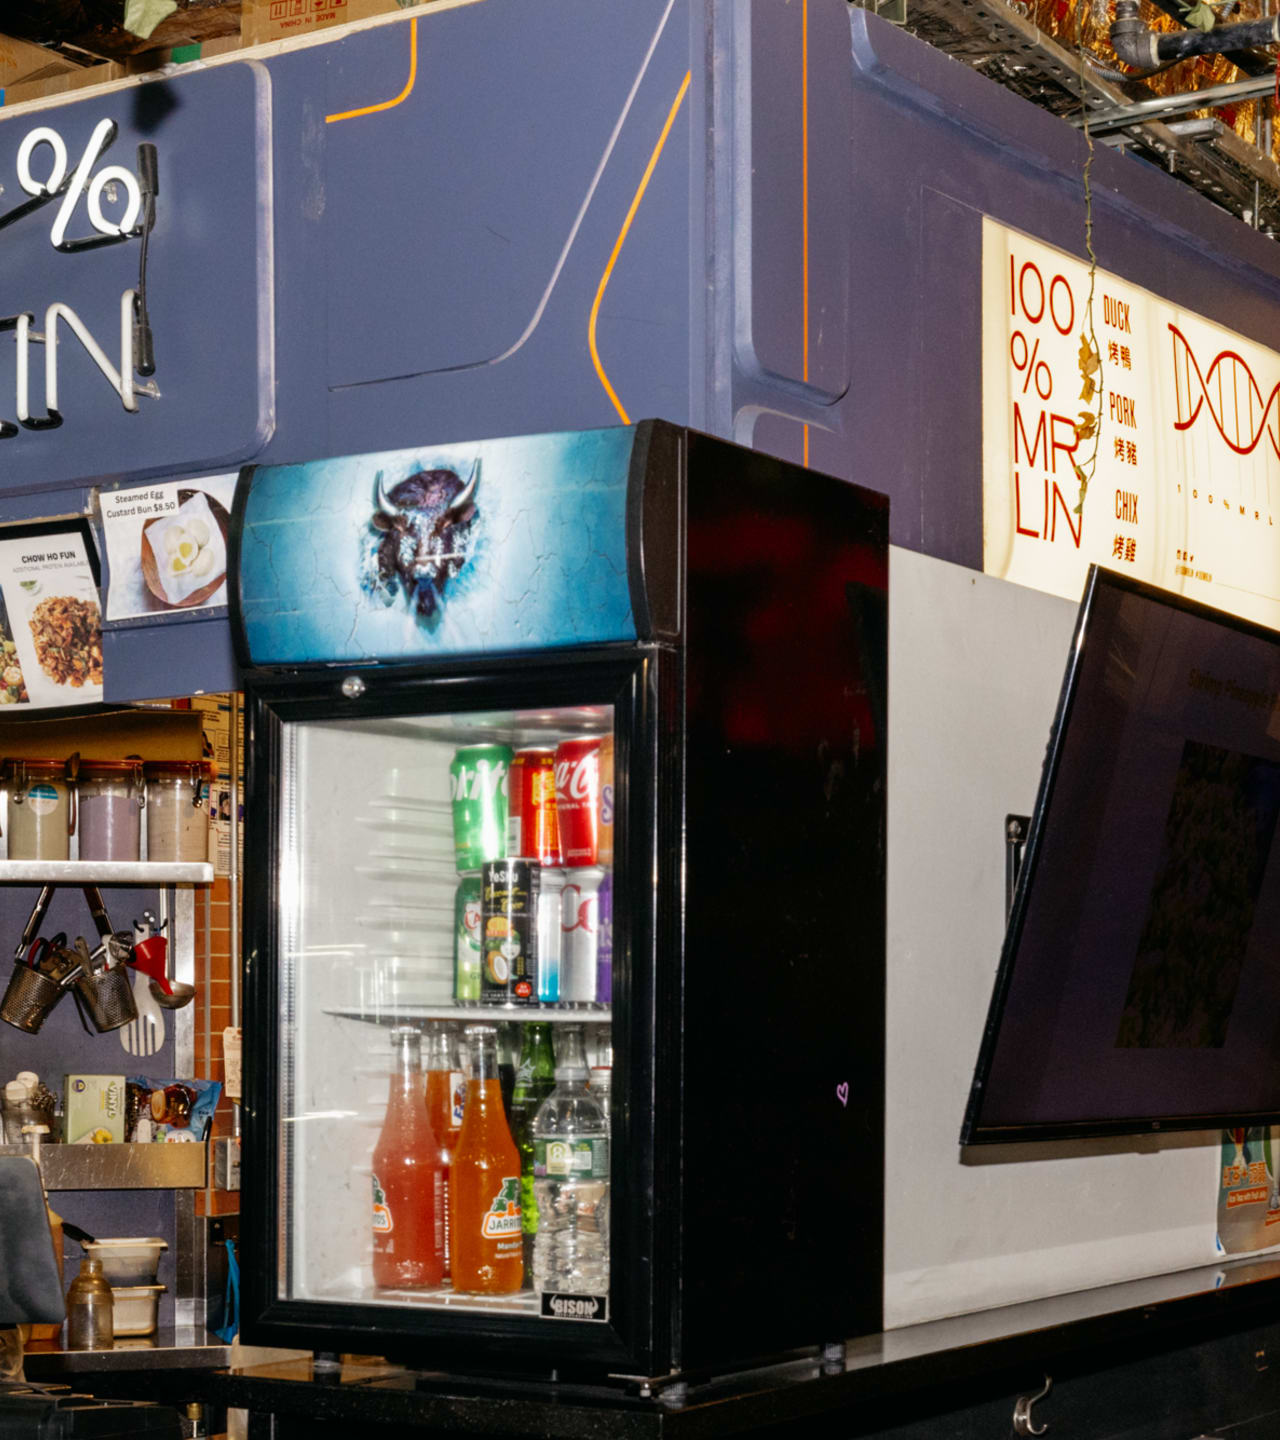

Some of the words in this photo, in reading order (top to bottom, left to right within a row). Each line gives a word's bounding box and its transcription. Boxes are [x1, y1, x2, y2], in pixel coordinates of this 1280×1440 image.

[1103, 293, 1132, 336] DUCK
[1109, 390, 1137, 431] PORK
[1012, 401, 1084, 482] MR
[106, 505, 135, 519] Custard
[136, 503, 152, 515] Bun
[153, 501, 176, 514] $8.50
[115, 492, 148, 506] Steamed
[149, 489, 164, 502] Egg
[1014, 470, 1083, 550] LIN
[1114, 488, 1139, 526] CHIX
[21, 554, 45, 564] CHOW
[47, 552, 59, 562] HO
[60, 550, 76, 561] FUN
[554, 1298, 594, 1315] BISON
